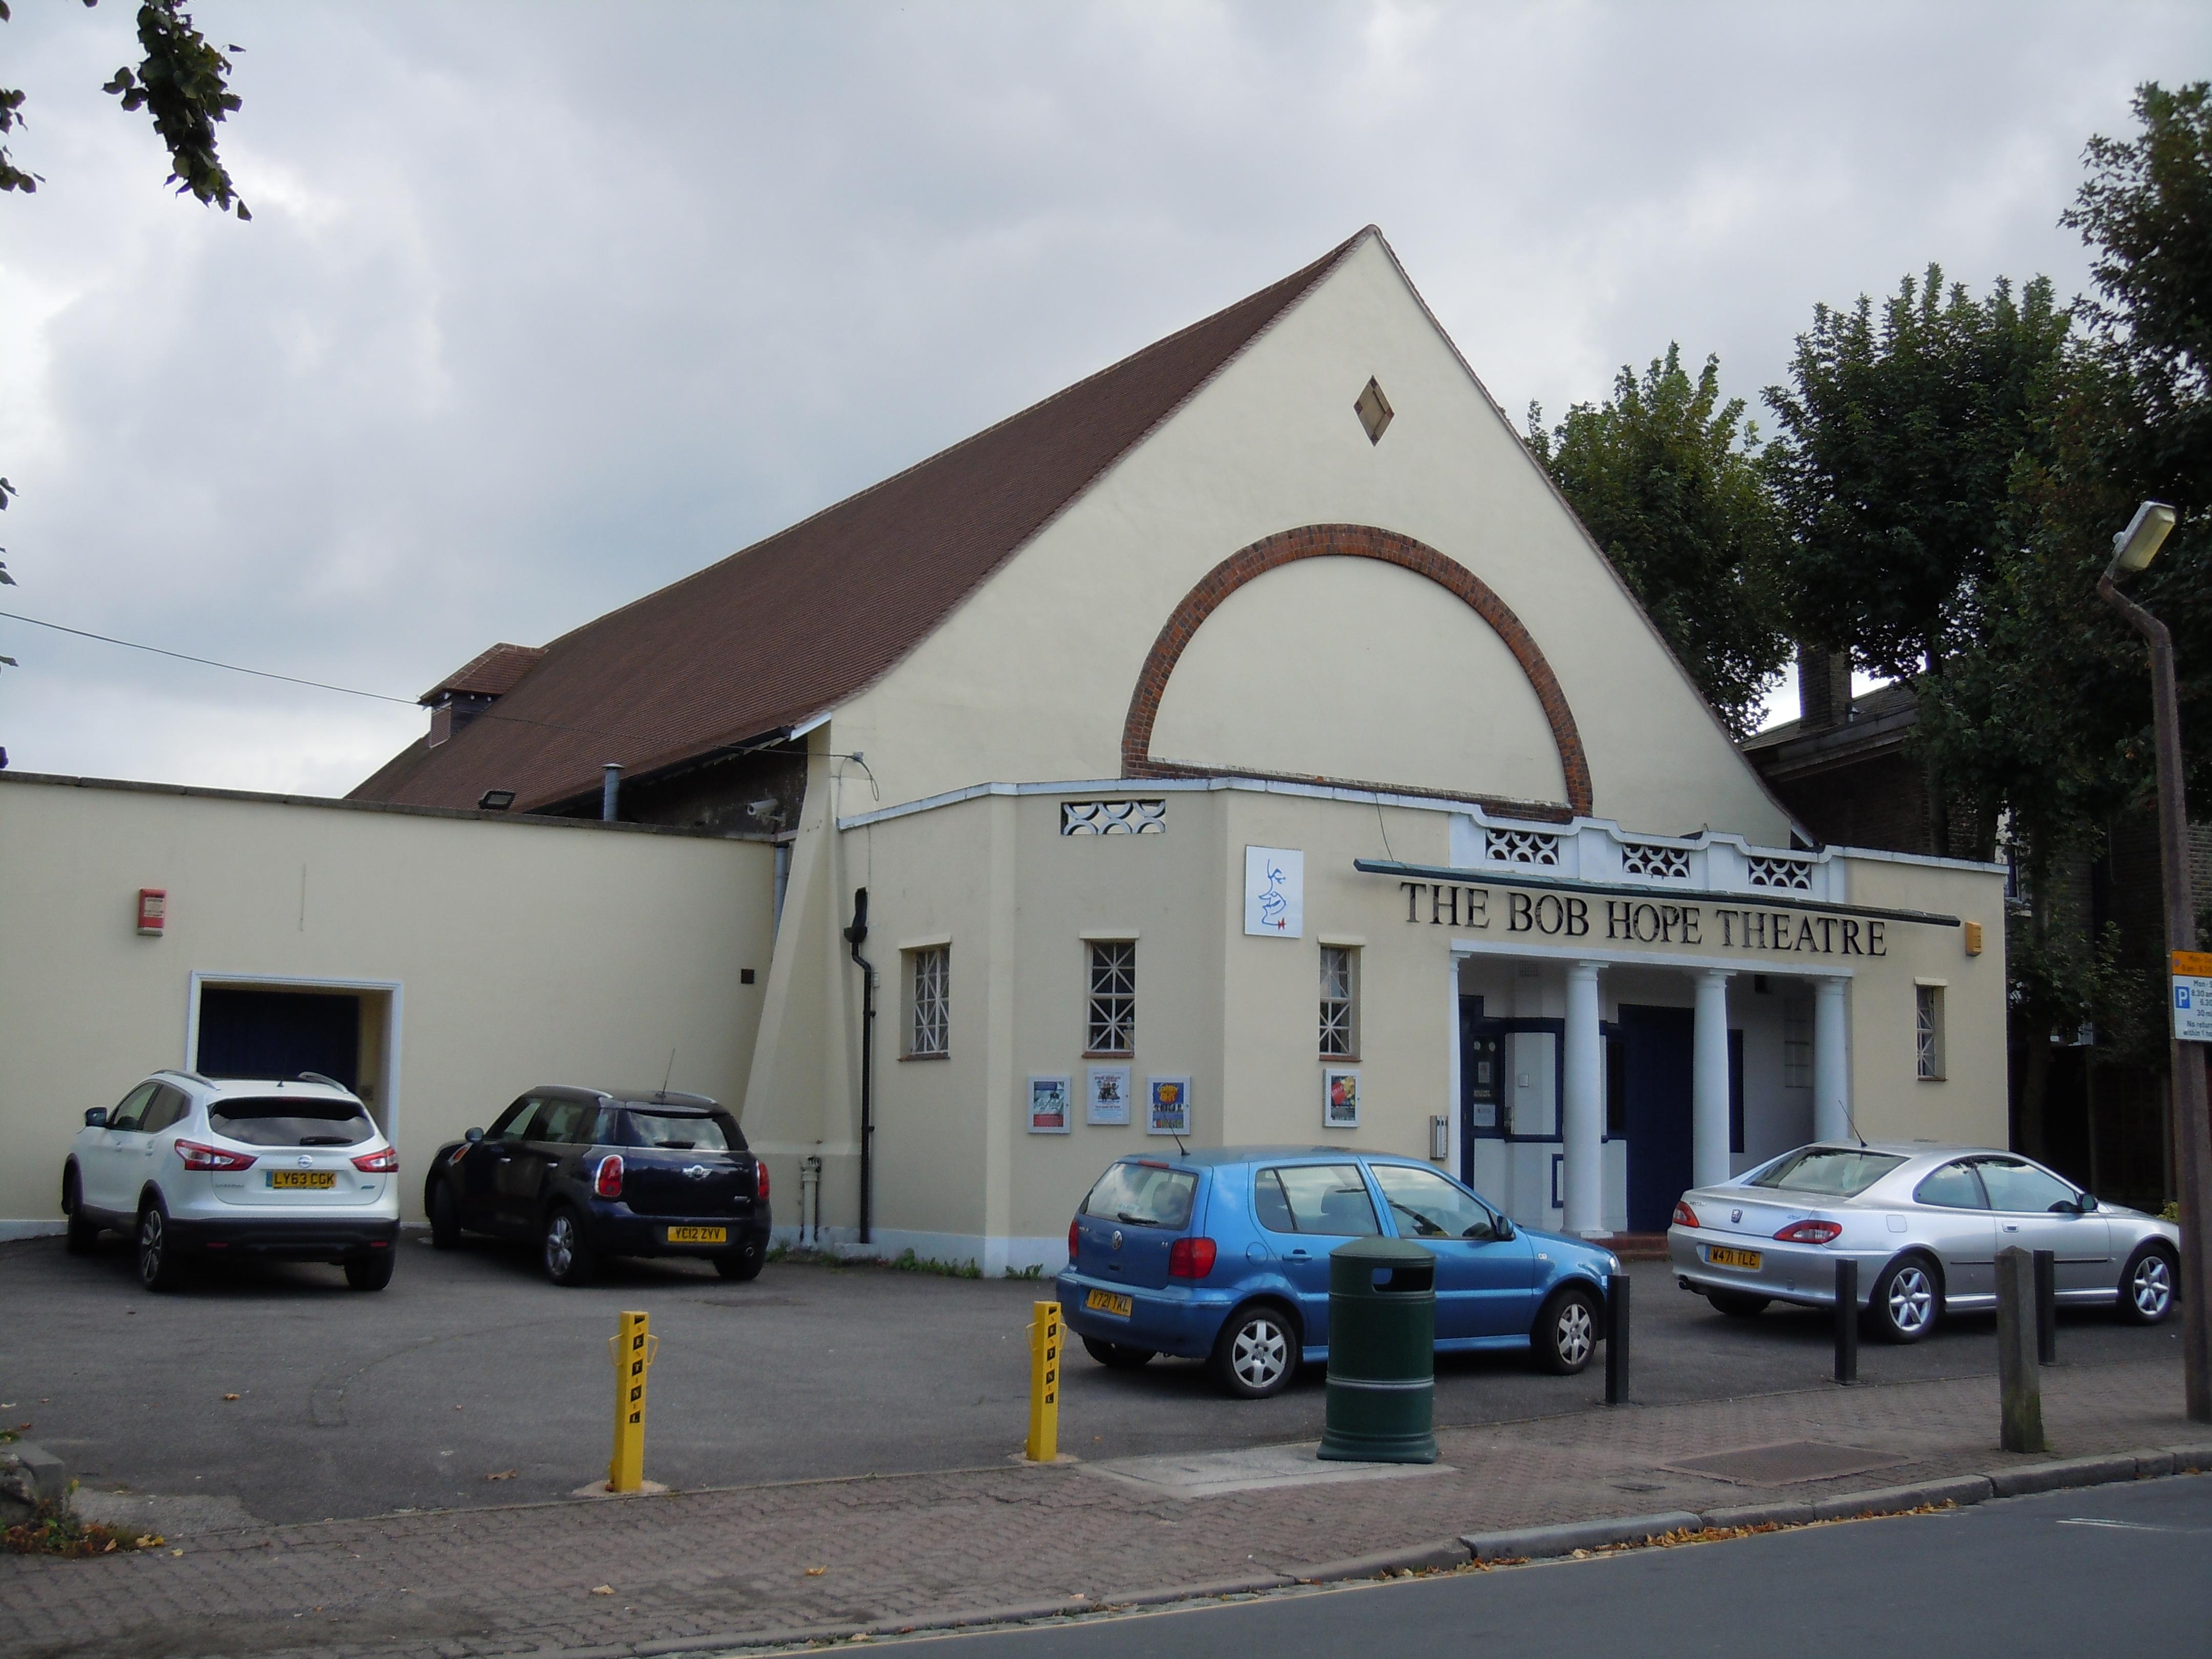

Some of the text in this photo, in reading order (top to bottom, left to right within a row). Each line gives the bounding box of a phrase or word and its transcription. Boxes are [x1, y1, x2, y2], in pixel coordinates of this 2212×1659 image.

[1400, 881, 1887, 956] THE BOB HOPE THEATRE
[274, 1173, 334, 1184] LY63 CGK
[675, 1228, 720, 1239] YC12 ZYV
[1712, 1249, 1733, 1263] W471
